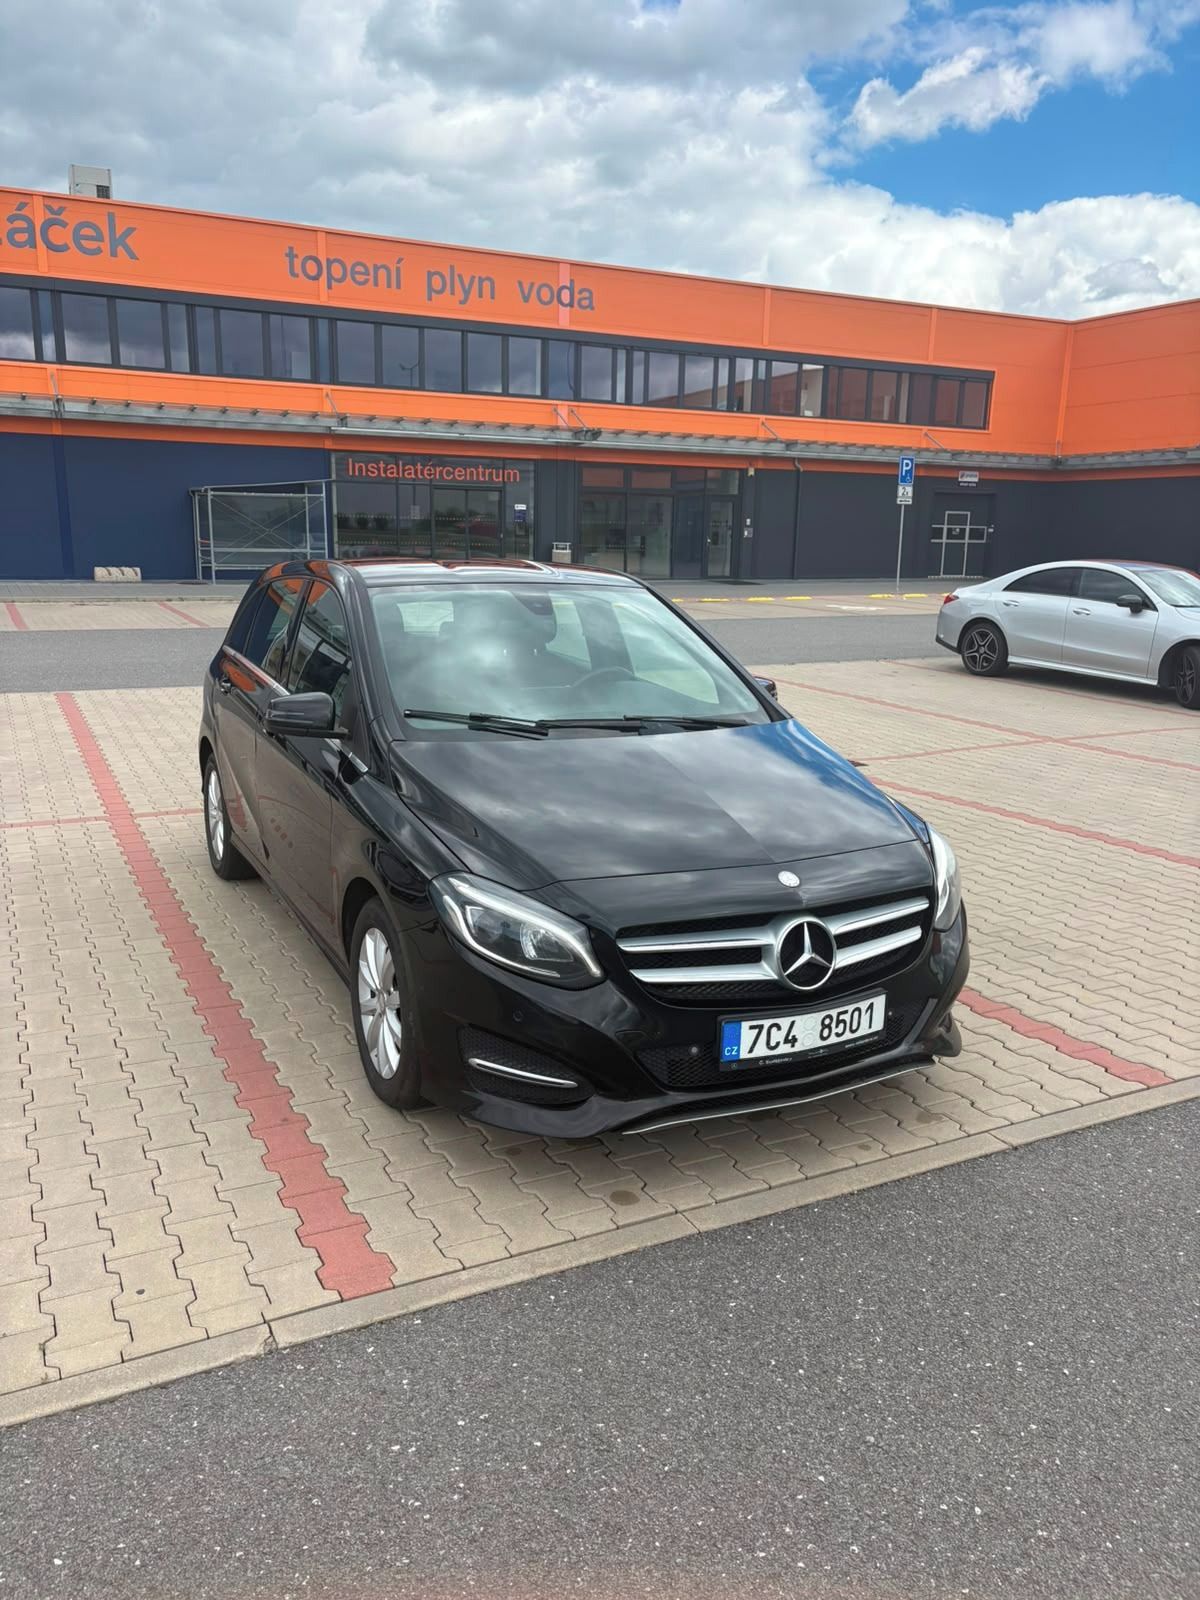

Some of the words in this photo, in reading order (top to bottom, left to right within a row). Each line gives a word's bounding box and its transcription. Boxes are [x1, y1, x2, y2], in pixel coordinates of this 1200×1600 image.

[0, 201, 139, 261] áček
[284, 246, 404, 290] topení
[426, 264, 496, 306] plyn
[517, 278, 595, 311] voda
[348, 458, 520, 482] Instalatércentrum
[902, 460, 912, 477] P
[747, 1020, 799, 1055] 7C4
[819, 1002, 875, 1042] 8501
[724, 1046, 738, 1056] CZ
